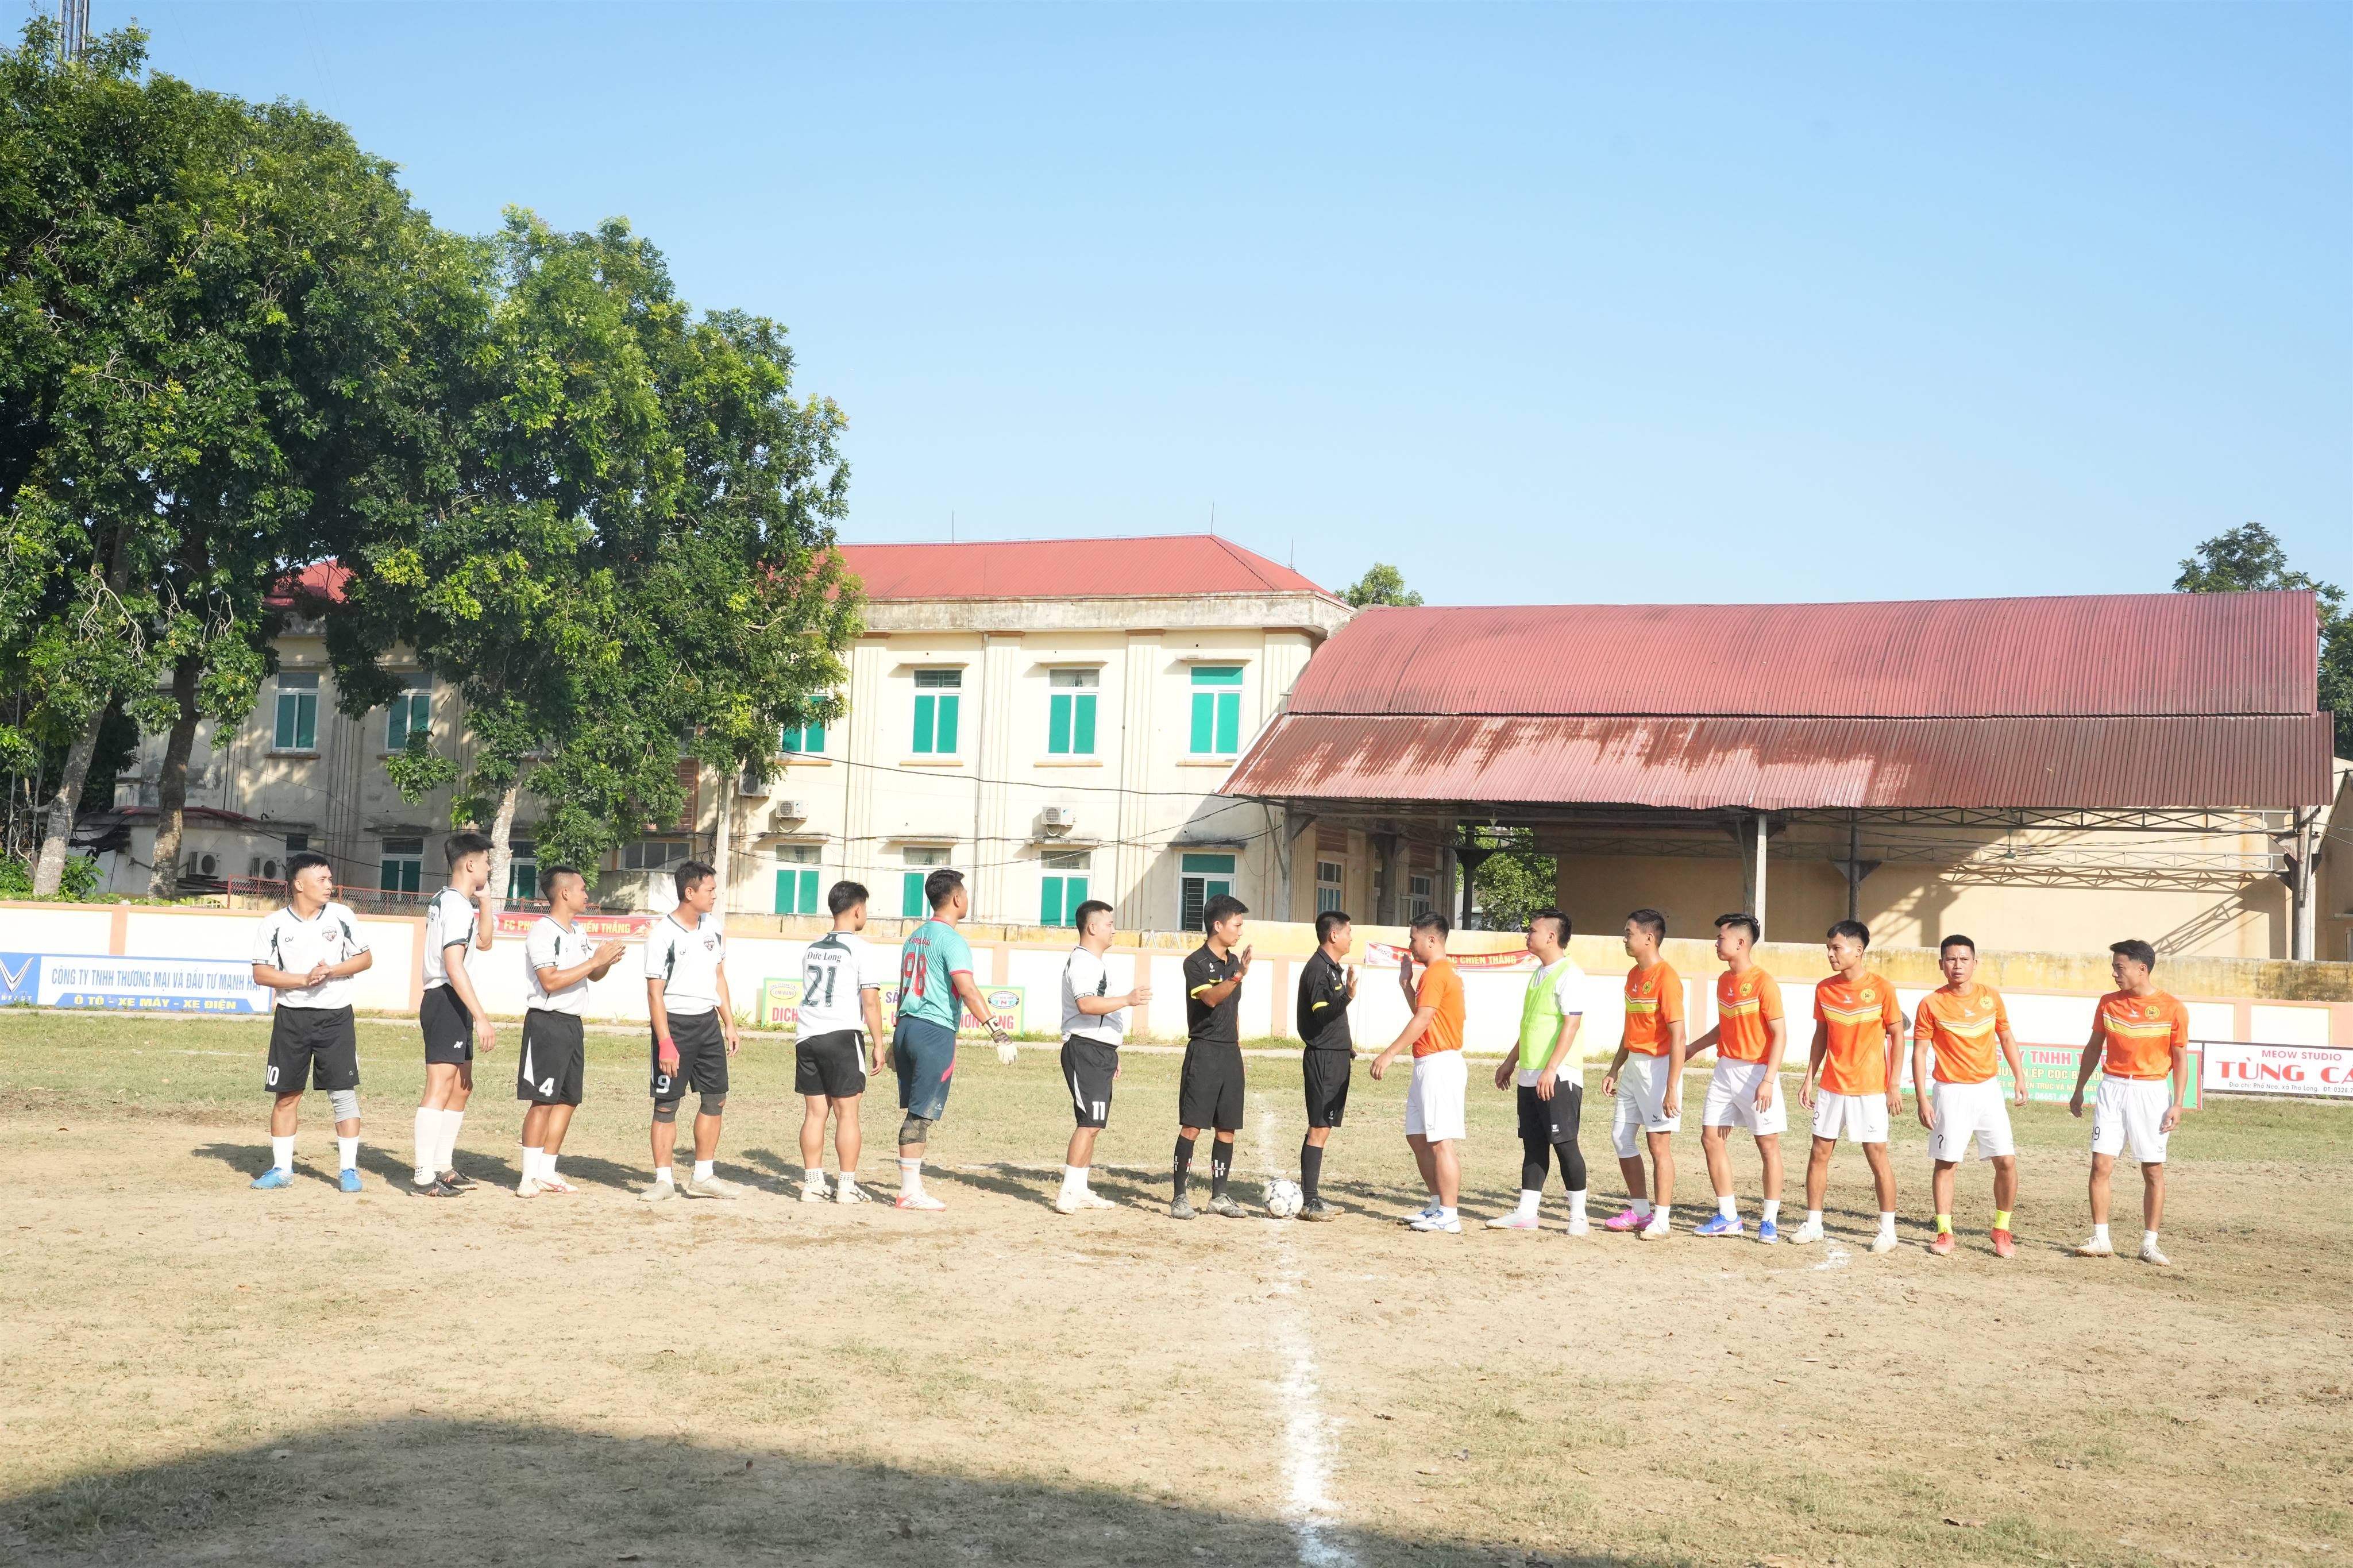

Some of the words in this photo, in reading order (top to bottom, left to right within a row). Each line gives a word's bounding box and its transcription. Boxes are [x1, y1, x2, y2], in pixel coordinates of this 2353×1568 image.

[504, 920, 515, 930] FC
[807, 951, 821, 960] Đức
[824, 952, 842, 963] Long
[52, 965, 76, 985] CÔNG
[79, 970, 89, 985] TY
[92, 970, 114, 986] TNHH
[117, 969, 151, 987] THƯƠNG
[153, 972, 170, 992] MẠI
[173, 968, 183, 988] VÀ
[206, 972, 218, 990] TƯ
[219, 974, 245, 994] MẠNH
[802, 964, 837, 1007] 21
[74, 994, 84, 1005] Ô
[88, 995, 104, 1005] TÔ
[118, 998, 136, 1006] XE
[140, 997, 170, 1007] MÁY
[183, 1000, 200, 1009] XE
[205, 999, 236, 1011] ĐIỆN
[2030, 1050, 2072, 1065] TNHH
[2262, 1050, 2297, 1059] MEOW
[2301, 1052, 2342, 1061] STUDIO
[266, 1065, 280, 1086] 10
[2031, 1065, 2045, 1078] ÉP
[2047, 1069, 2068, 1081] CỌC
[2215, 1057, 2305, 1082] TÙNG
[539, 1077, 555, 1097] 4
[656, 1075, 671, 1094] 9
[1092, 1101, 1105, 1120] 11
[2092, 1126, 2101, 1141] 9
